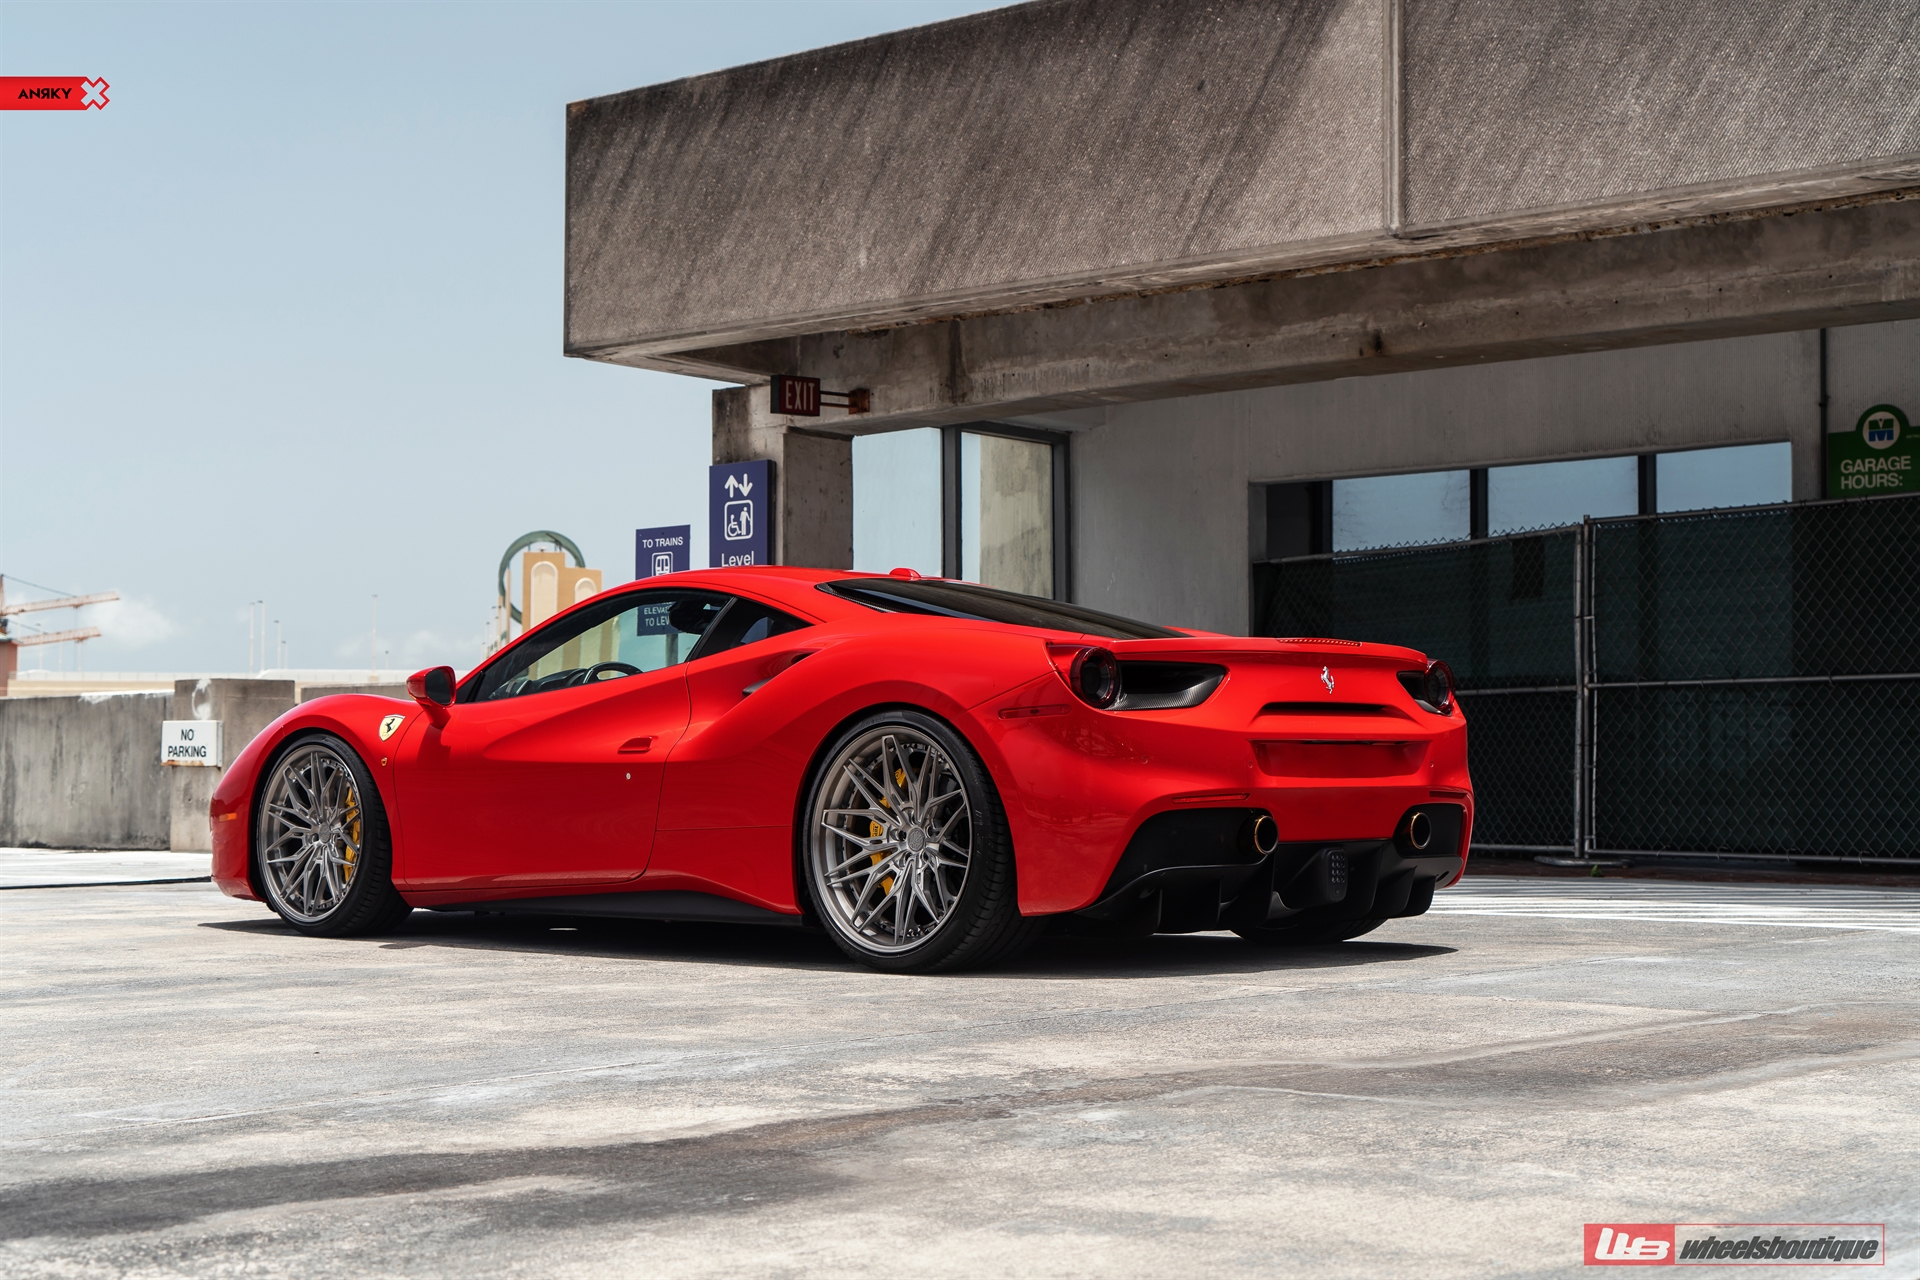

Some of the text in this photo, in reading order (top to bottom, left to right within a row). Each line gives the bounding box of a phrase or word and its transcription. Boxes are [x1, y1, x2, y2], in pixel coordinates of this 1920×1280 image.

[785, 380, 815, 411] EXIT
[1840, 455, 1912, 474] GARAGE
[1840, 472, 1903, 490] HOURS:
[642, 536, 684, 549] TO TRAINS
[721, 550, 755, 567] Level
[643, 604, 672, 615] ELEVAT
[645, 615, 670, 627] TO LEV
[180, 728, 195, 741] NO
[167, 745, 207, 758] PARKING
